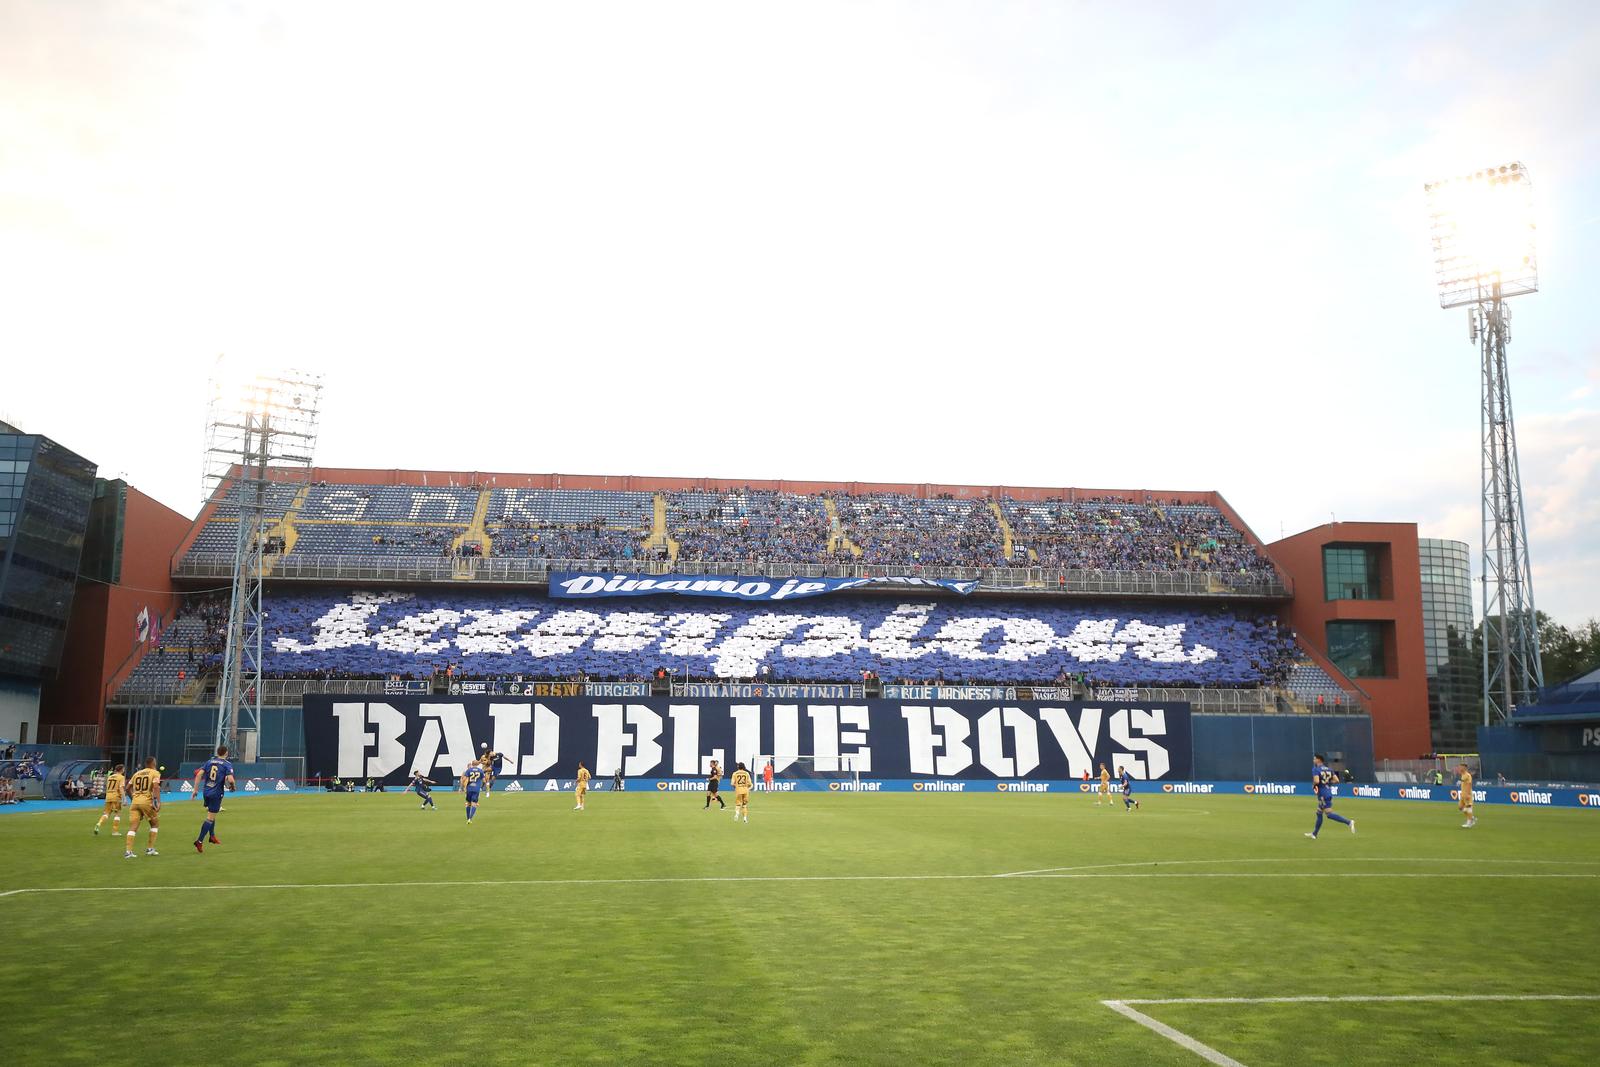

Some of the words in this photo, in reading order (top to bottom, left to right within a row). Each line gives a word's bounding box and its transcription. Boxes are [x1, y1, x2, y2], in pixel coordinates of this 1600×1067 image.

[560, 575, 771, 596] Dinamo
[770, 579, 826, 600] je
[689, 685, 751, 698] DINAMO
[767, 686, 846, 698] SVETINJA
[901, 686, 932, 699] BLUE
[938, 687, 991, 700] MADNESS
[333, 702, 560, 778] BAD
[592, 703, 871, 777] BLUE
[901, 705, 1171, 780] BOYS
[209, 765, 218, 781] 6
[736, 774, 747, 785] 23
[135, 776, 149, 791] 90
[841, 781, 882, 791] mlinar
[925, 781, 965, 791] mlinar
[1009, 781, 1050, 792] mlinar
[1174, 782, 1213, 793] mlinar
[1255, 782, 1296, 794] mlinar
[1358, 785, 1381, 797] mlinar
[1405, 786, 1431, 799] mlinar
[1519, 789, 1552, 804] mlinar
